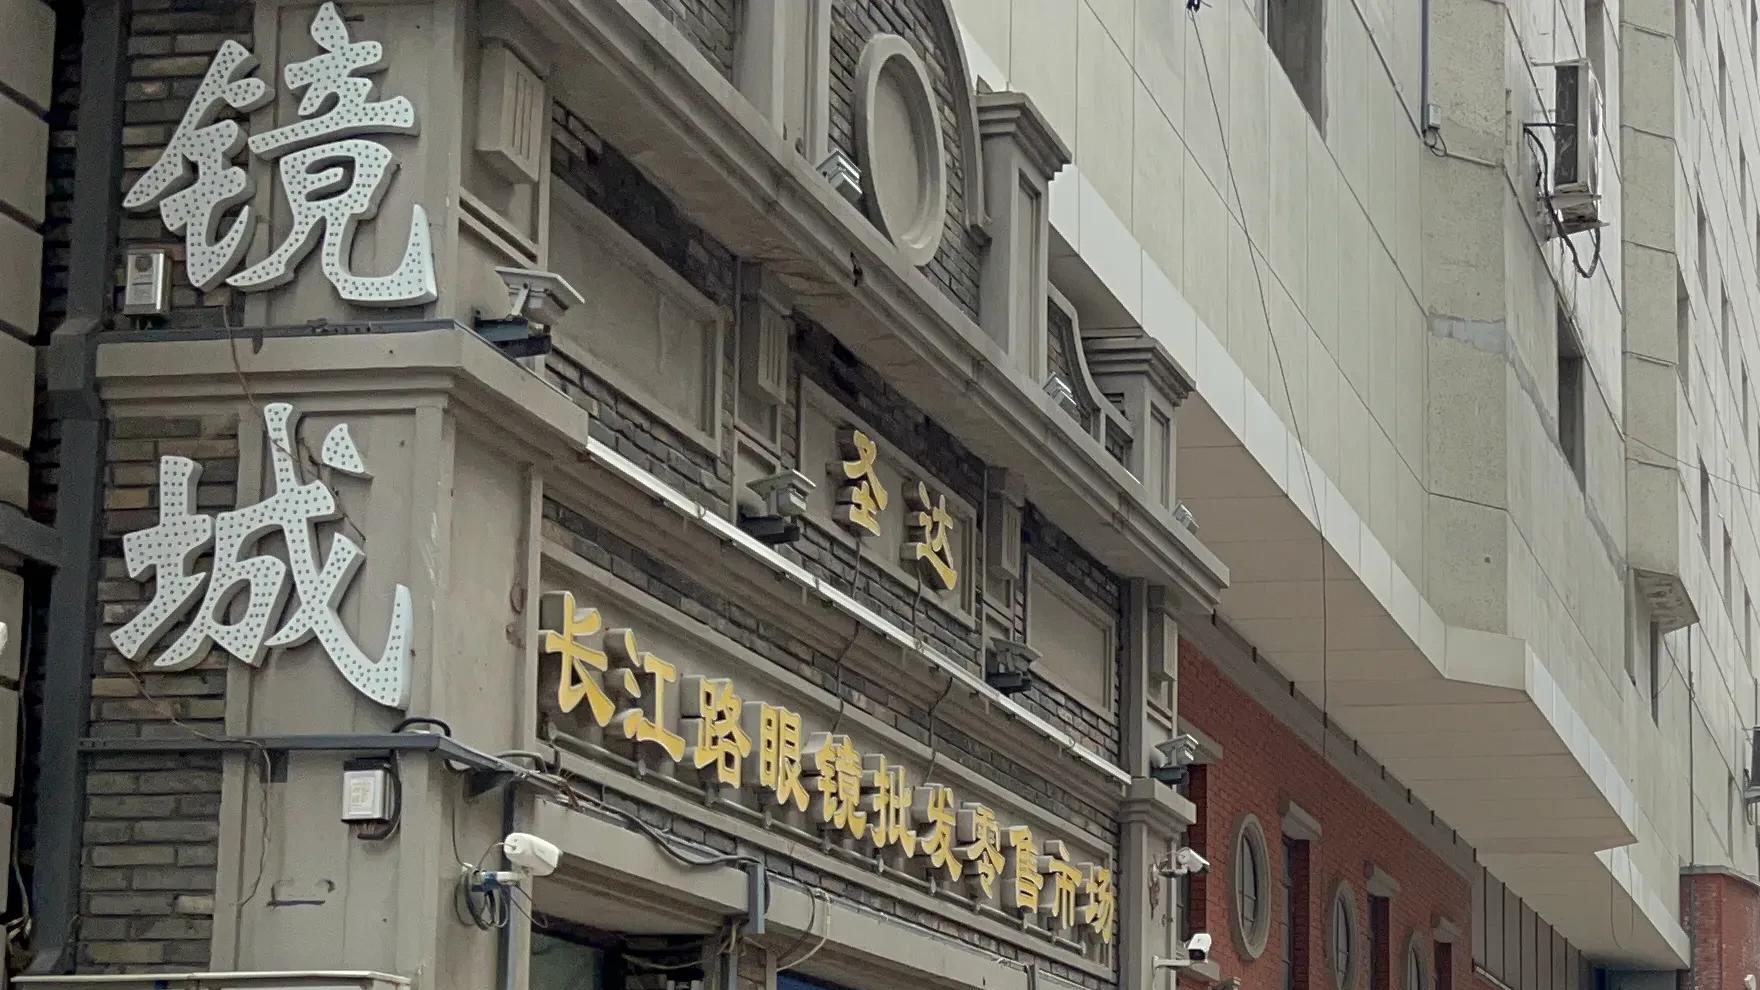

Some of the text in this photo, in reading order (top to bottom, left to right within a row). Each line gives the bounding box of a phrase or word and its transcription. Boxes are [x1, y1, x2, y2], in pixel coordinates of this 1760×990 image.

[110, 2, 438, 708] 镜城
[843, 430, 957, 590] 圣达
[544, 591, 1117, 943] 长江路眼镜批发零售市场
